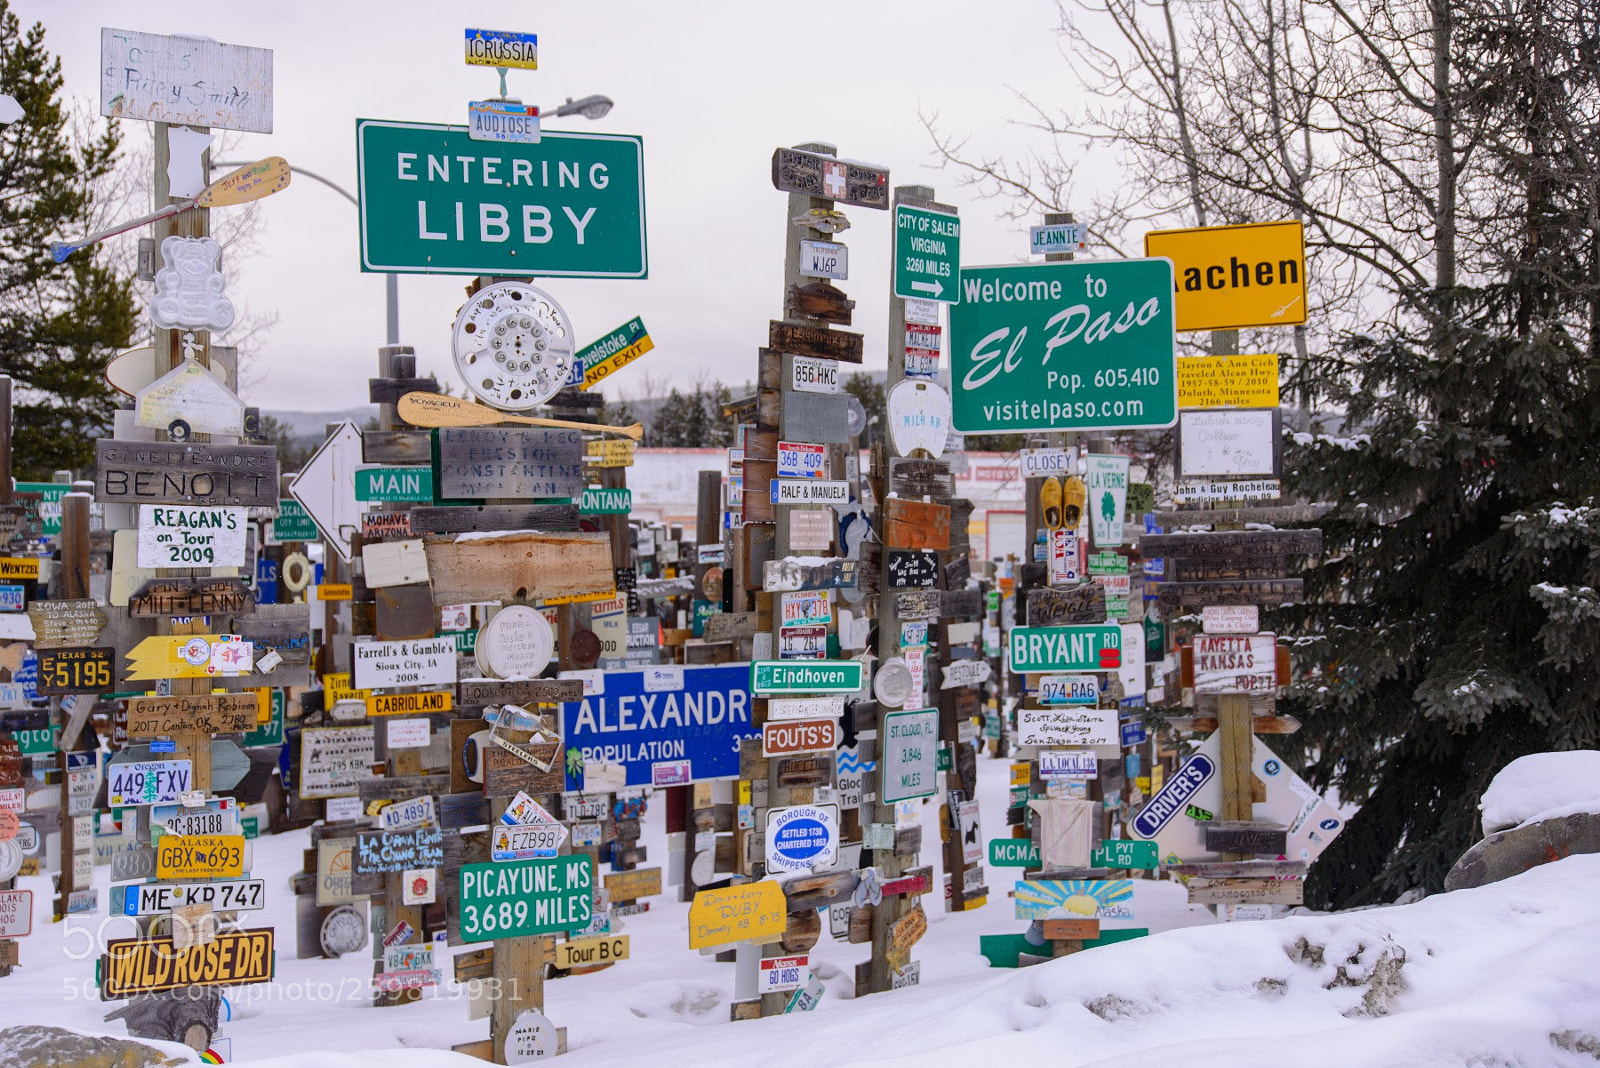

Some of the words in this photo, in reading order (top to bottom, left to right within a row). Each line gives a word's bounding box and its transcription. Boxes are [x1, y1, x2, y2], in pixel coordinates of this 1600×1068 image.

[469, 38, 534, 62] ICRUSSIA
[476, 115, 532, 134] AUDIOSE
[398, 152, 610, 189] ENTERING
[221, 176, 240, 190] JEFF
[418, 201, 597, 244] LIBBY
[899, 214, 916, 230] CITY
[919, 218, 930, 232] OF
[932, 220, 959, 238] SALEM
[1033, 229, 1079, 246] JEANNIE
[911, 237, 946, 256] VIRGINIA
[906, 257, 924, 273] 3260
[926, 261, 950, 276] MILES
[1174, 256, 1298, 292] achen
[964, 278, 1062, 303] Welcome
[1086, 274, 1108, 298] to
[962, 326, 1026, 390] El
[1042, 296, 1161, 366] Paso
[586, 366, 608, 384] NO
[612, 342, 643, 366] EXIT
[1216, 360, 1225, 368] &
[796, 366, 814, 382] 856
[818, 367, 836, 384] HKC
[1047, 372, 1086, 393] Pop.
[1094, 367, 1160, 389] 605,410
[1219, 369, 1247, 377] Alcan
[1250, 369, 1274, 377] Hwy.
[1181, 379, 1235, 387] 1957-58-59
[1179, 389, 1216, 397] Duluth,
[1220, 388, 1271, 396] Minnesota
[983, 399, 1144, 428] visitelpaso.com
[781, 451, 798, 467] 36B
[804, 453, 822, 468] 409
[1027, 455, 1071, 470] CLOSEY
[105, 470, 268, 497] BENOIT
[370, 474, 420, 494] MAIN
[1091, 472, 1100, 488] LA
[1103, 473, 1125, 489] VERNE
[781, 485, 800, 498] RALF
[803, 485, 809, 497] &
[811, 486, 846, 499] MANUELA
[1174, 485, 1196, 495] John
[1200, 484, 1206, 492] &
[1210, 484, 1228, 494] Guy
[572, 492, 630, 509] MONTANA
[154, 508, 237, 530] REAGAN'S
[367, 514, 407, 526] MOHAVE
[157, 532, 172, 542] on
[180, 532, 214, 545] Tour
[368, 528, 408, 538] ARIZONA
[170, 546, 214, 563] 2009
[1, 562, 38, 573] WENTZEL
[36, 602, 68, 611] IOWA
[137, 596, 174, 614] MILT
[189, 593, 248, 613] LENNY
[785, 602, 800, 619] HXY
[358, 646, 397, 658] Farrell's
[401, 645, 408, 655] &
[412, 642, 453, 656] Gamble's
[804, 636, 818, 650] 261
[1014, 633, 1096, 665] BRYANT
[1104, 633, 1118, 648] RD
[375, 662, 400, 670] Sioux
[404, 660, 424, 670] City,
[428, 659, 437, 668] IA
[1201, 654, 1254, 670] KANSAS
[57, 661, 110, 687] 5195
[395, 674, 419, 682] 2008
[772, 668, 845, 683] Eindhoven
[1043, 683, 1066, 698] 974
[1071, 683, 1094, 697] RA6
[136, 701, 171, 715] Gary
[217, 698, 256, 711] Robison
[376, 694, 443, 713] CABRIOLAND
[574, 689, 746, 735] ALEXANDR
[133, 720, 158, 732] 2017
[196, 718, 211, 728] OK
[891, 726, 900, 738] ST.
[902, 724, 923, 737] CLOUD,
[925, 722, 933, 734] FL.
[768, 725, 832, 748] FOUTS'S
[1024, 735, 1044, 744] San
[502, 741, 538, 764] STEELERS
[581, 740, 685, 763] POPULATION
[902, 748, 922, 763] 3,846
[134, 763, 165, 771] Oregon
[1057, 757, 1080, 769] LOCAL
[113, 773, 144, 796] 449
[156, 770, 189, 794] FXV
[901, 773, 920, 788] MILES
[1143, 766, 1203, 828] DRIVER'S
[776, 808, 817, 826] BOROUGH
[819, 812, 830, 823] OF
[512, 831, 554, 850] EZB98
[782, 828, 806, 838] SETTLED
[808, 827, 822, 837] 1730
[777, 839, 811, 849] CHARTERED
[812, 838, 827, 847] 1853
[1116, 843, 1134, 853] PVT
[162, 848, 193, 868] GBX
[208, 847, 240, 867] 693
[1118, 855, 1132, 865] RD
[463, 865, 562, 899] PICAYUNE,
[566, 862, 590, 890] MS
[142, 888, 171, 910] ME
[221, 884, 261, 907] 747
[465, 900, 528, 936] 3,689
[535, 894, 590, 926] MILES
[716, 900, 761, 918] DUBY
[1095, 905, 1130, 918] Alaska
[698, 924, 731, 938] Donnelly
[737, 918, 750, 928] AB
[565, 946, 594, 964] Tour
[600, 942, 609, 958] B
[612, 940, 623, 957] C
[116, 943, 170, 988] WILD
[173, 938, 234, 983] ROSE
[235, 936, 265, 978] DR
[770, 971, 779, 984] GO
[780, 968, 799, 982] HOGS
